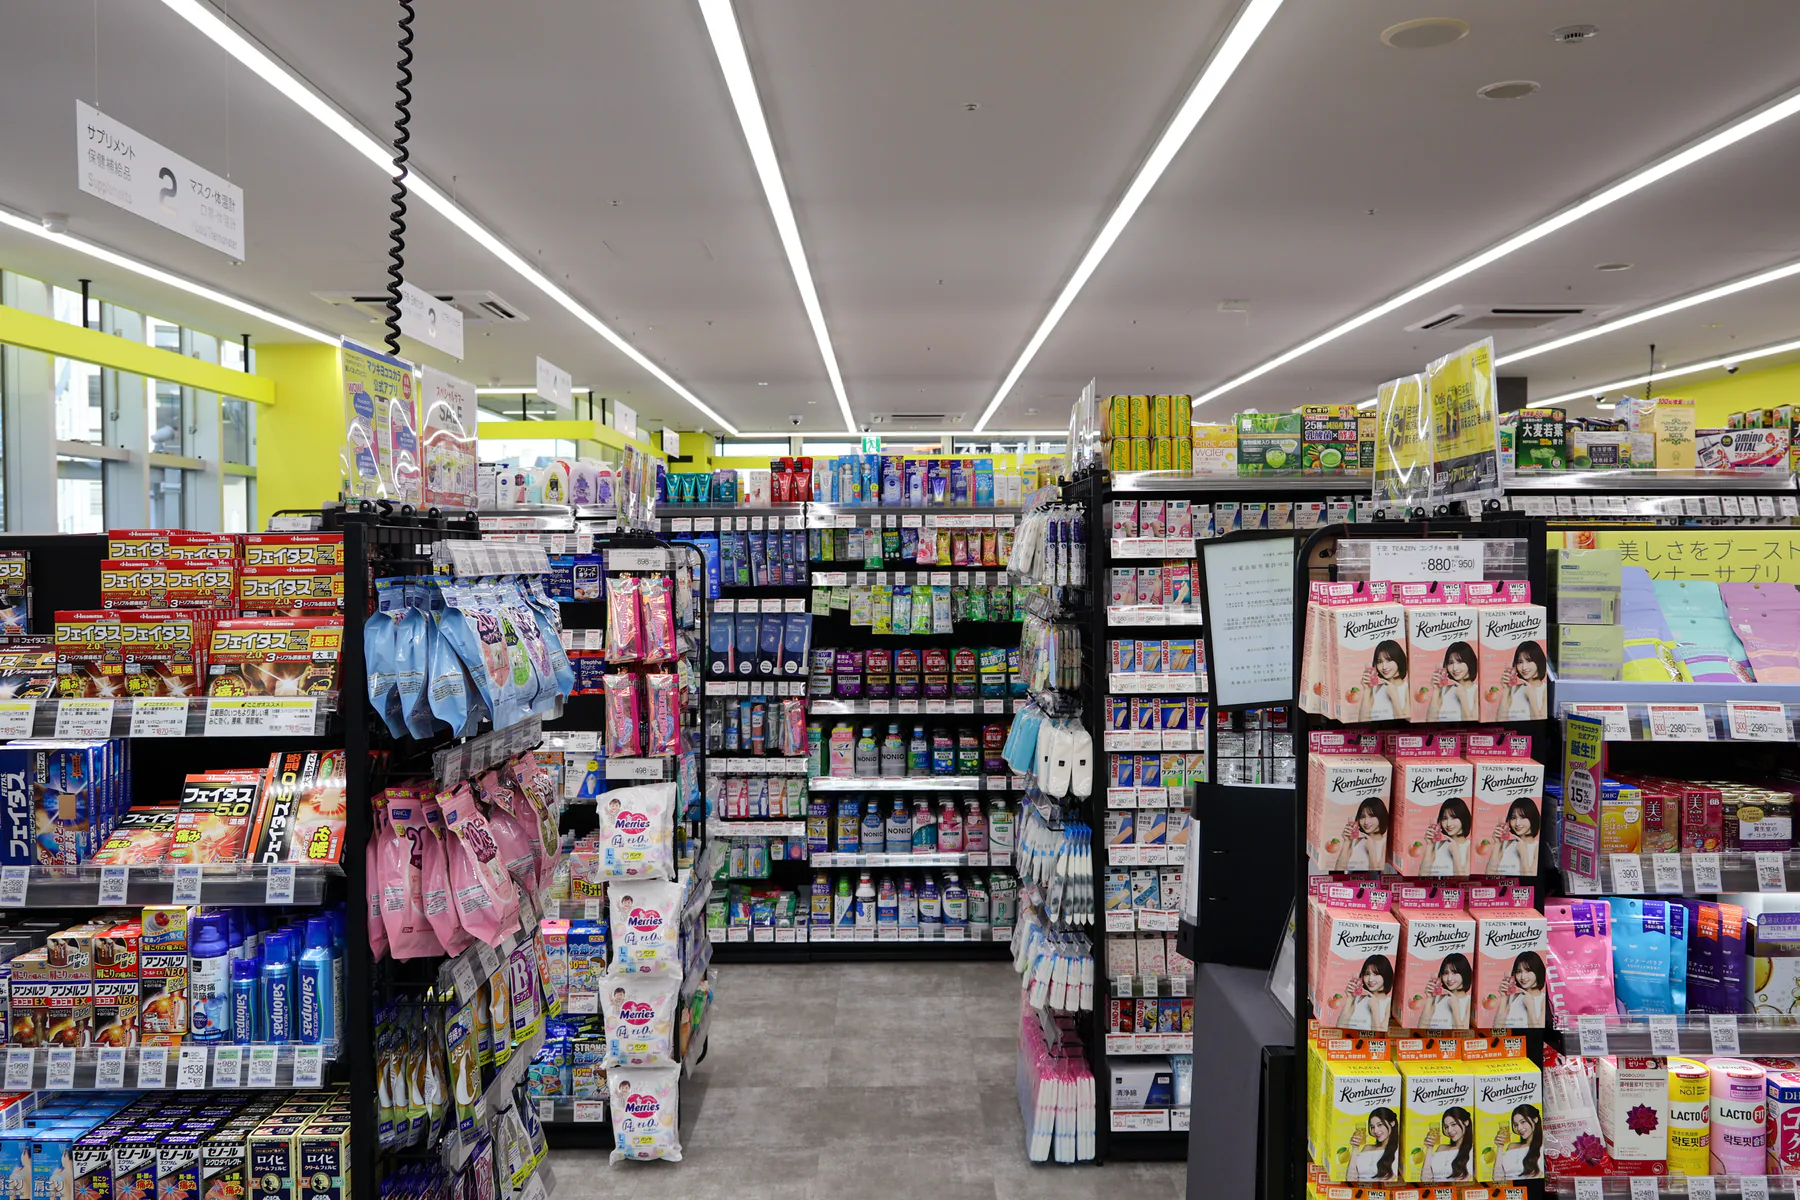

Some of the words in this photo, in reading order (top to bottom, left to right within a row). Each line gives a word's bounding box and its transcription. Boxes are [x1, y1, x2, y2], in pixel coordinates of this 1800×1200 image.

[87, 124, 135, 160] サプリメント
[158, 166, 179, 217] 2
[366, 360, 401, 382] マツキヨココカラ
[374, 379, 398, 397] 公式アプリ
[1305, 421, 1357, 430] 25種の純国産野菜
[1522, 423, 1564, 438] 大麦若葉
[1304, 430, 1357, 441] 乳酸菌×酵素
[1734, 432, 1763, 443] amino
[1194, 440, 1218, 448] CITRIC
[1219, 440, 1236, 448] ACID
[1734, 442, 1756, 452] VITAL
[248, 548, 315, 565] フェイタス
[1427, 558, 1451, 571] 880
[103, 572, 167, 588] フェイタス
[169, 572, 231, 588] フェイタス
[1164, 567, 1172, 596] BAND-AID
[243, 579, 311, 597] フェイタス
[1343, 615, 1400, 638] Kombucha
[1416, 616, 1473, 638] Kombucha
[1485, 615, 1542, 638] Kombucha
[57, 625, 121, 641] フェイタス
[123, 625, 191, 642] フェイタス
[1369, 631, 1397, 640] コンブチャ
[1511, 631, 1537, 641] コンブチャ
[214, 632, 287, 650] フェイタス
[310, 635, 338, 647] 温感
[102, 665, 123, 675] 温感
[172, 665, 194, 675] 温感
[1570, 722, 1599, 734] マツキヨココカラ
[1670, 724, 1686, 732] 2980
[1751, 723, 1767, 732] 2980
[1578, 733, 1599, 742] 公式アプリ
[1571, 740, 1596, 759] 誕生!!
[1331, 772, 1387, 793] Kombucha
[1411, 773, 1468, 794] Kombucha
[1481, 772, 1539, 793] Kombucha
[183, 788, 253, 803] フェイタス
[1436, 788, 1463, 797] コンブチャ
[1688, 794, 1703, 810] 美
[7, 771, 29, 857] フェイタス
[214, 803, 250, 816] 5.0
[1645, 800, 1661, 819] 美
[615, 819, 650, 830] Merries
[1603, 823, 1629, 831] そばかす
[175, 830, 201, 843] 痛み
[309, 825, 332, 860] 痛み
[1622, 869, 1638, 878] 3900
[628, 916, 663, 927] Merries
[1337, 927, 1394, 948] Kombucha
[1413, 926, 1471, 948] Kombucha
[1485, 926, 1543, 948] Kombucha
[569, 943, 605, 956] 冷却シート
[1361, 944, 1388, 952] コンブチャ
[144, 956, 184, 967] アンメルツ
[569, 961, 578, 969] 10
[1624, 957, 1663, 966] インナーバリア
[12, 970, 48, 979] 肩こりの痛みに
[49, 969, 90, 979] 肩こりの痛みに
[96, 969, 137, 979] 肩こりの痛みに
[164, 967, 185, 977] NEO
[12, 986, 47, 996] アンメルツ
[50, 985, 89, 996] アンメルツ
[96, 984, 136, 996] アンメルツ
[13, 998, 33, 1006] ヨコヨコ
[34, 998, 46, 1006] EX
[51, 998, 72, 1006] ヨコヨコ
[74, 997, 87, 1006] EX
[95, 997, 115, 1005] ヨコヨコ
[116, 995, 136, 1005] NEO
[301, 975, 315, 1037] Salonpas
[120, 1005, 138, 1017] ロング
[271, 983, 286, 1036] Salonpas
[619, 1009, 655, 1020] Merries
[1112, 1000, 1120, 1027] BAND-AID
[1136, 1000, 1144, 1027] BAND-AID
[235, 993, 248, 1040] Salonpas
[187, 1065, 204, 1074] 1538
[1115, 1089, 1137, 1097] 清浄綿
[1340, 1084, 1396, 1103] Kombucha
[1412, 1083, 1469, 1103] Kombucha
[1480, 1082, 1537, 1103] Kombucha
[1680, 1086, 1696, 1096] NO.1
[1365, 1099, 1391, 1107] コンブチャ
[1506, 1097, 1533, 1105] コンブチャ
[625, 1102, 660, 1114] Merries
[1720, 1107, 1752, 1121] LACTO
[1754, 1110, 1765, 1120] FIT
[1670, 1109, 1700, 1121] LACTO
[1671, 1135, 1699, 1148] 락토핏
[1723, 1133, 1752, 1146] 락토핏
[74, 1151, 109, 1162] ゼノール
[117, 1149, 152, 1159] ゼノール
[159, 1150, 194, 1161] ゼノール
[207, 1147, 239, 1157] ゼノール
[256, 1154, 284, 1165] ロイヒ
[306, 1154, 335, 1165] ロイヒ
[34, 1180, 63, 1191] 肩こり
[136, 1180, 154, 1190] 痛み
[178, 1180, 197, 1191] 痛み
[1583, 1189, 1599, 1197] 769
[1639, 1189, 1655, 1197] 2481
[1749, 1189, 1765, 1197] 2200
